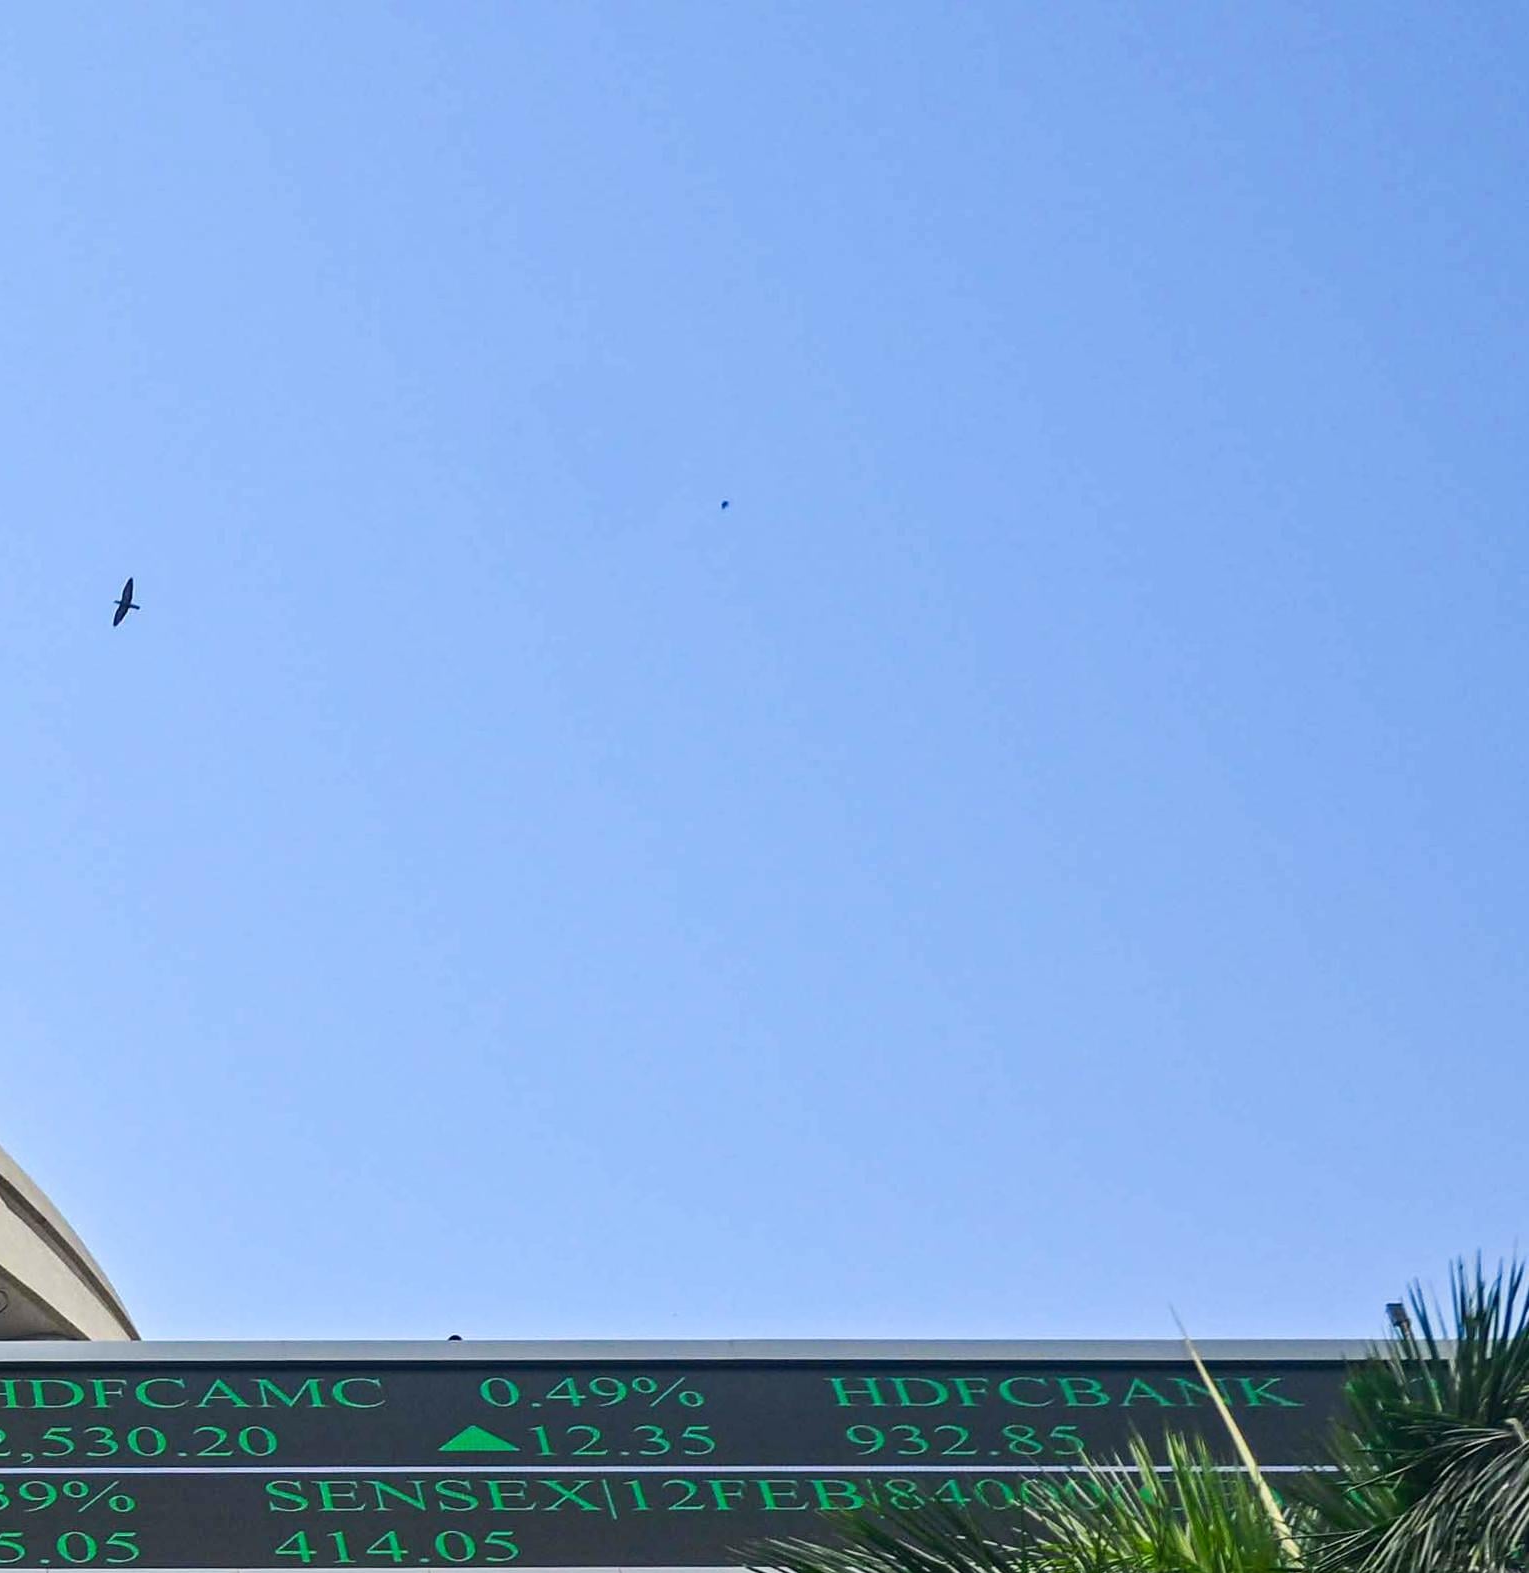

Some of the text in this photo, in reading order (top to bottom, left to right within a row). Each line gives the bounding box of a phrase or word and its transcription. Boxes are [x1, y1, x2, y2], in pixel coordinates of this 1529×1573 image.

[479, 1376, 704, 1408] 0.49%
[822, 1376, 1305, 1408] HDFCBANK
[534, 1425, 717, 1456] 12.35
[846, 1425, 1085, 1456] 932.85
[274, 1530, 521, 1563] 414.05
